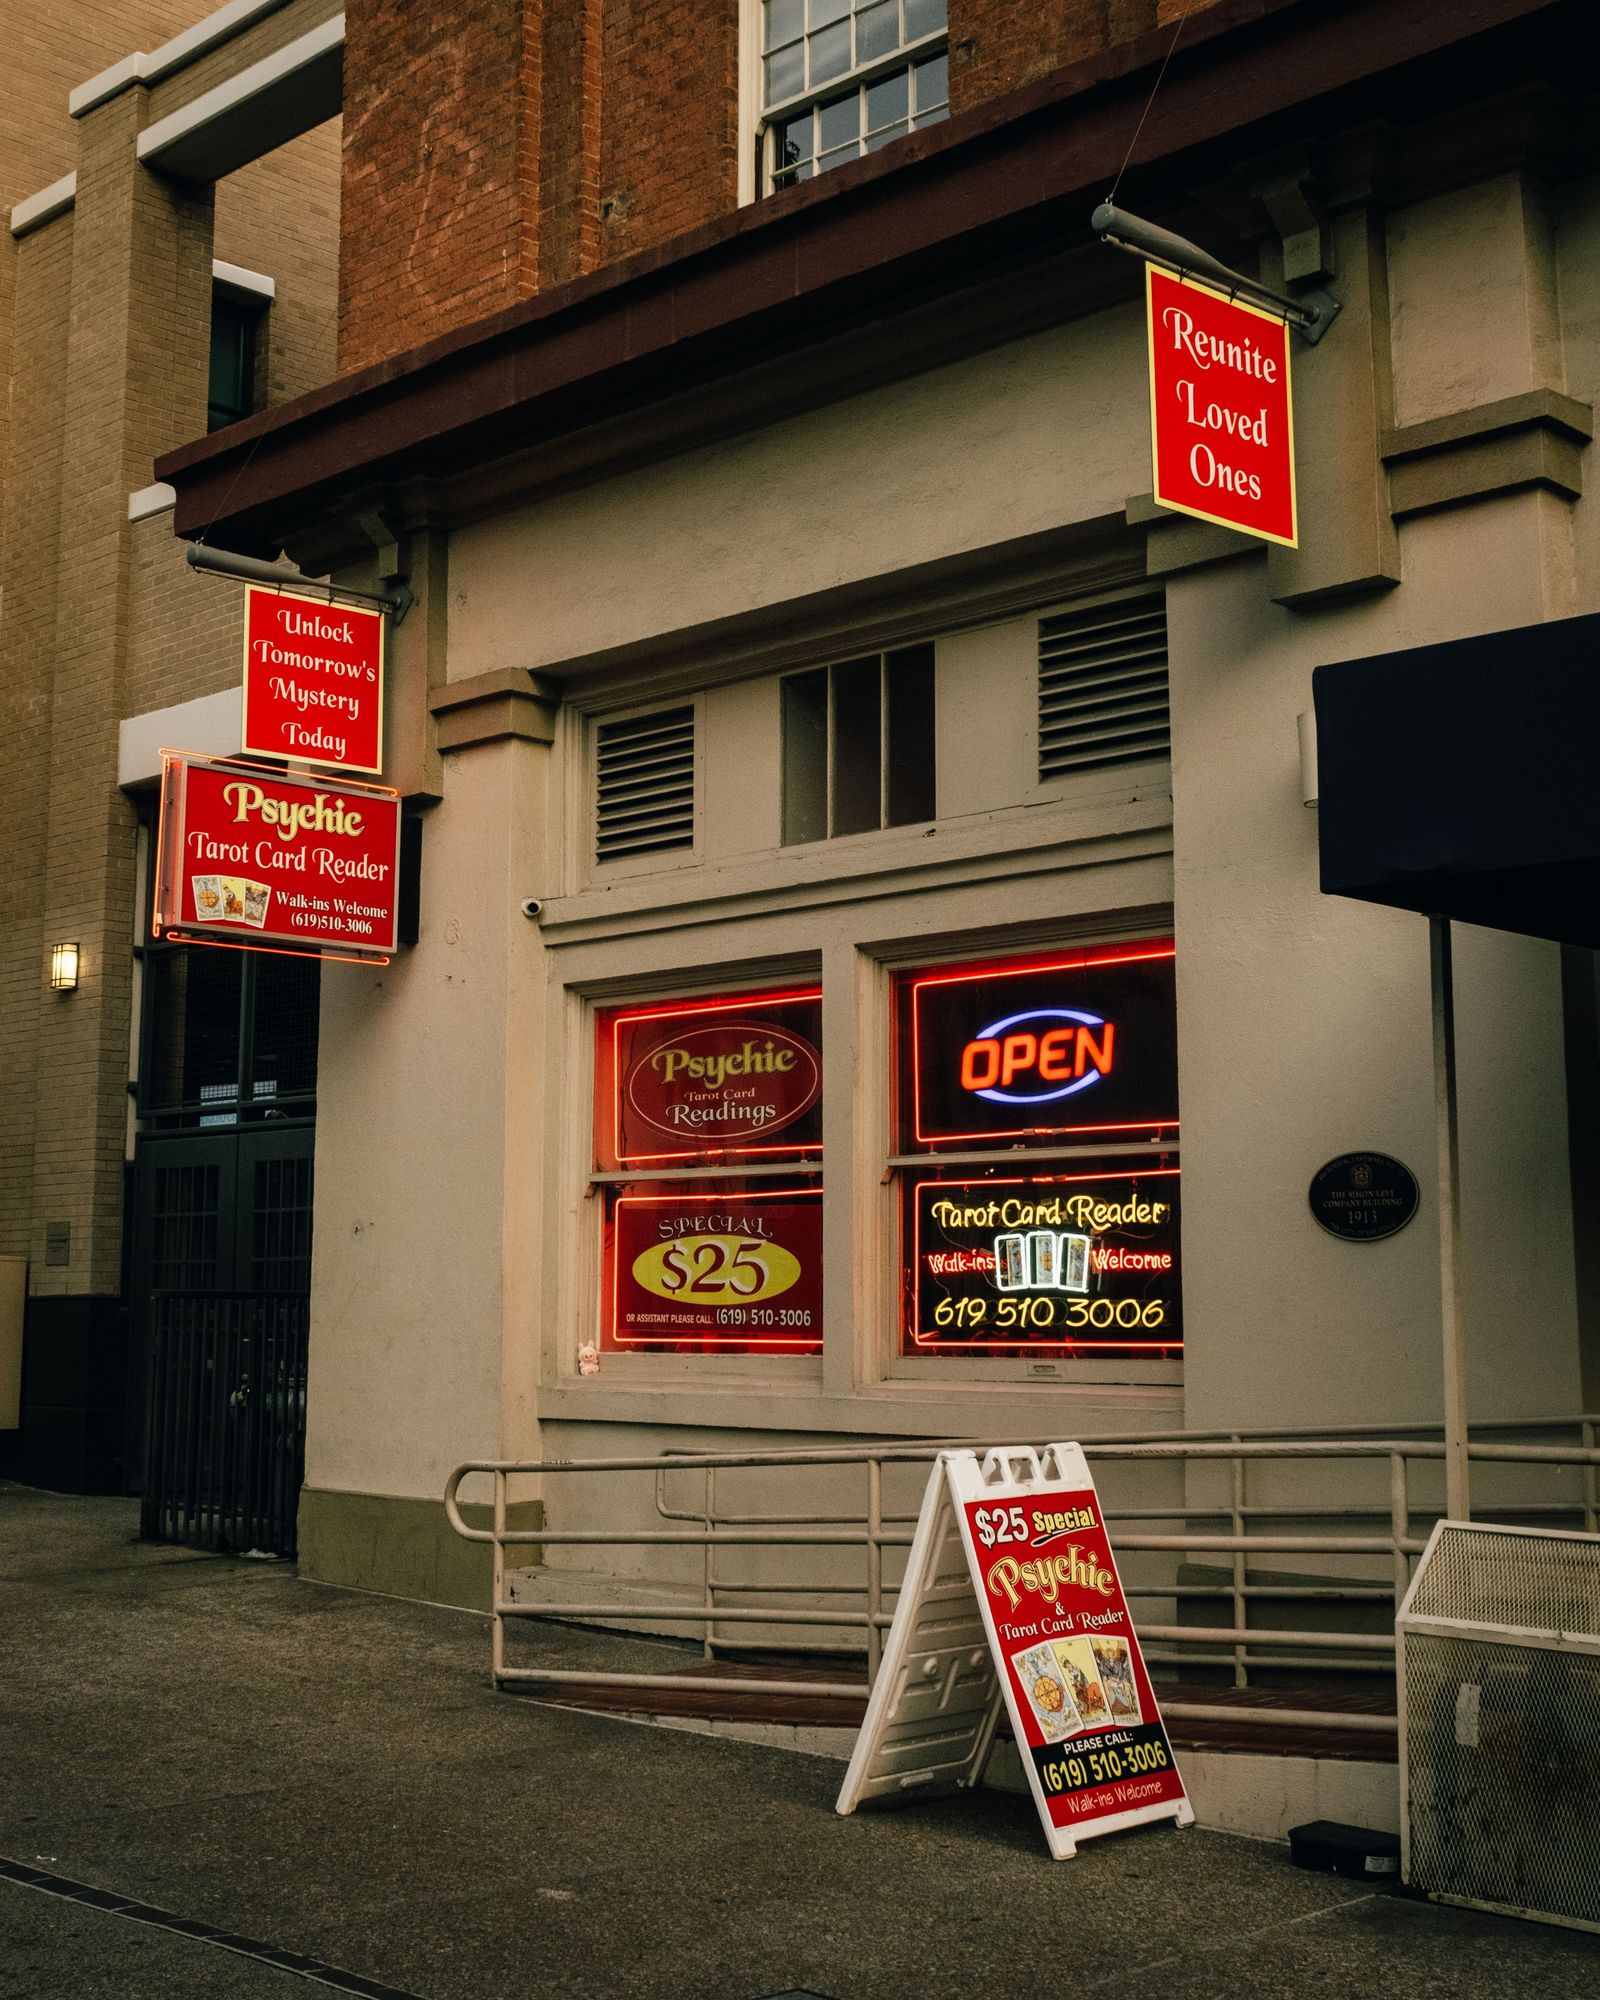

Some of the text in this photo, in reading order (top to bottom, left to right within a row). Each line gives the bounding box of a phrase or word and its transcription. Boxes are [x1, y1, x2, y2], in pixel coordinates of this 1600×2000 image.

[1163, 307, 1276, 383] Reunite
[1176, 380, 1268, 447] Loved
[1190, 443, 1261, 500] Ones
[277, 609, 354, 644] Unlock
[253, 640, 376, 682] Tomorrow's
[269, 677, 359, 720] Mystery
[281, 722, 347, 760] Today
[223, 782, 365, 842] Psychic
[188, 832, 389, 884] Tarot Card Reader
[276, 891, 388, 918] Walk-ins Welcome
[291, 912, 373, 935] (619)510-3006
[651, 1040, 798, 1089] Psychic
[961, 1023, 1114, 1091] OPEN
[684, 1087, 755, 1103] Tarot Card
[665, 1101, 777, 1127] Readings
[931, 1194, 1165, 1231] Tarot Card Reader
[1323, 1198, 1403, 1208] COMPANY BUILDING
[1348, 1210, 1377, 1224] 1913
[658, 1214, 773, 1238] SPECIAL
[660, 1238, 770, 1296] $25
[927, 1247, 1172, 1274] Walk-ins Welcome
[626, 1308, 811, 1327] OR ASSISTANT PLEASE CALL: (619) 510-3006
[935, 1297, 1164, 1328] 619 510 3006
[974, 1505, 1096, 1549] $25 Special
[988, 1543, 1115, 1613] Psychic
[999, 1608, 1125, 1642] Tarot Card Reader
[1055, 1601, 1066, 1616] &
[1063, 1731, 1135, 1755] PLEASE CALL:
[1043, 1740, 1168, 1792] (619) 510-3006
[1067, 1779, 1162, 1815] Walk-ins Welcome
